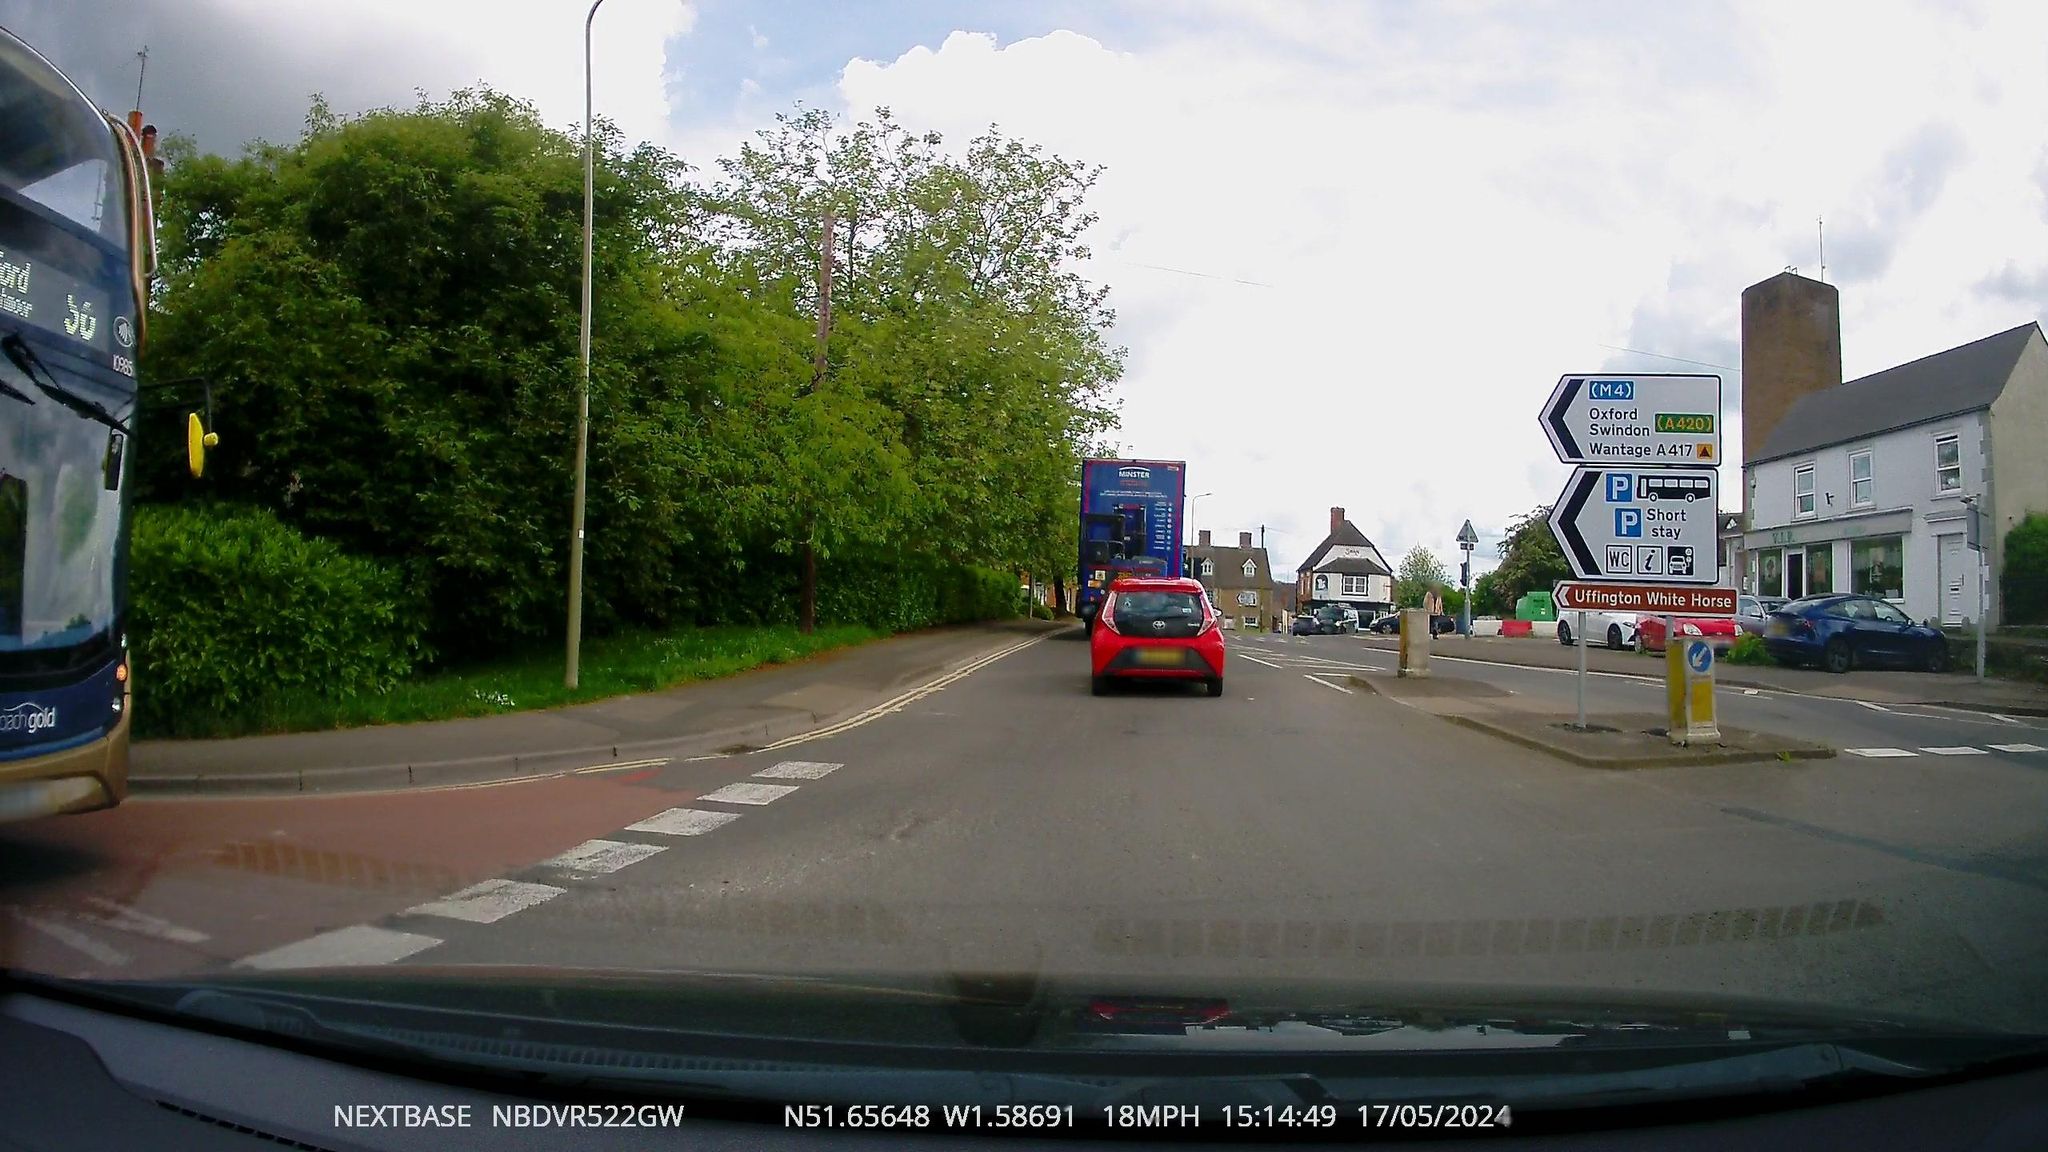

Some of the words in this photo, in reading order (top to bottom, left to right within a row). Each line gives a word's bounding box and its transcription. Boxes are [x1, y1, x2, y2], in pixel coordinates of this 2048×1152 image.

[1591, 382, 1632, 399] (M4)
[1589, 408, 1638, 420] Oxford
[1589, 423, 1650, 436] Swindon
[1656, 416, 1712, 431] (A420)
[1589, 443, 1651, 458] Wantage
[1656, 444, 1693, 457] A417
[1612, 476, 1629, 500] P
[1621, 511, 1638, 535] P
[1646, 508, 1686, 522] Short
[1652, 526, 1681, 540] stay
[1609, 552, 1630, 567] WC
[1575, 589, 1641, 605] Uffington
[1647, 592, 1684, 606] White
[1691, 594, 1732, 608] Horse
